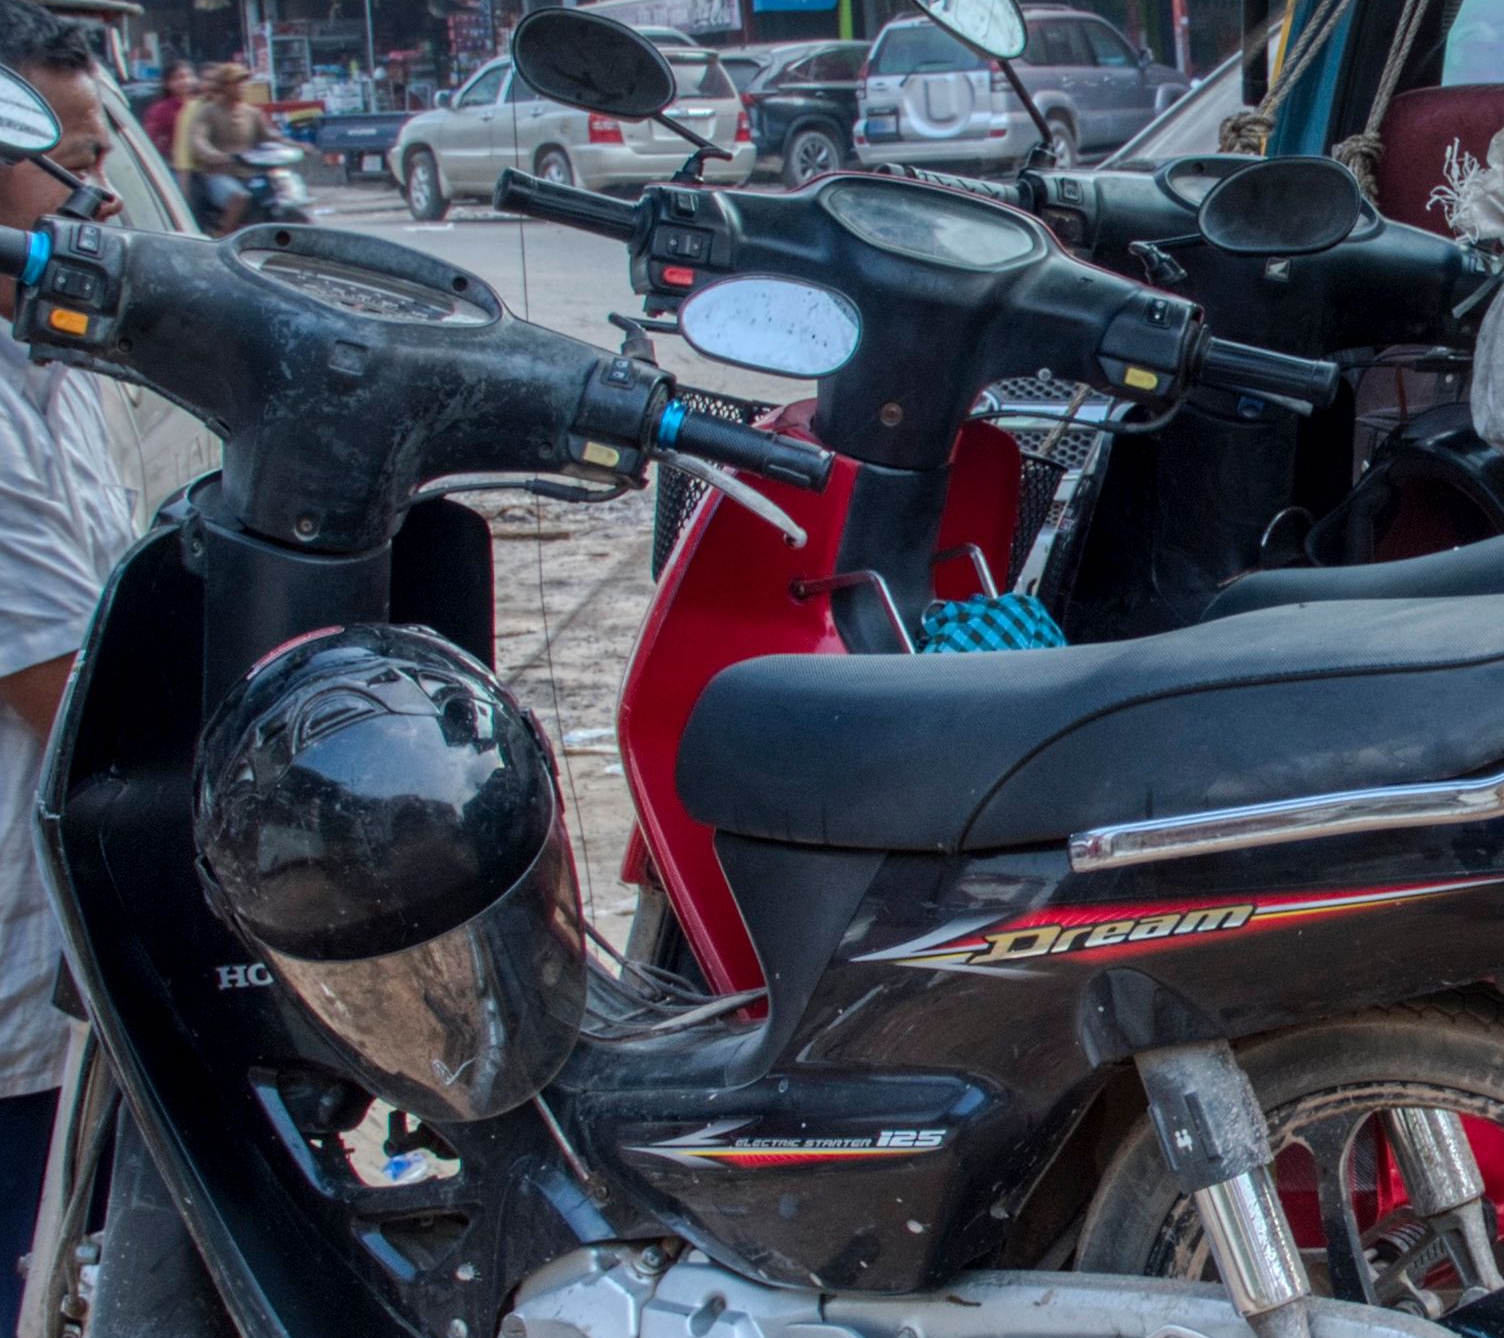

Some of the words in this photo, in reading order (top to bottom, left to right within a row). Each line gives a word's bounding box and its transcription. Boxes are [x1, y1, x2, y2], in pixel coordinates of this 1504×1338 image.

[968, 903, 1257, 965] Dream
[734, 1137, 801, 1149] ELECTRIC
[803, 1137, 871, 1149] STARTER
[876, 1129, 947, 1148] 125
